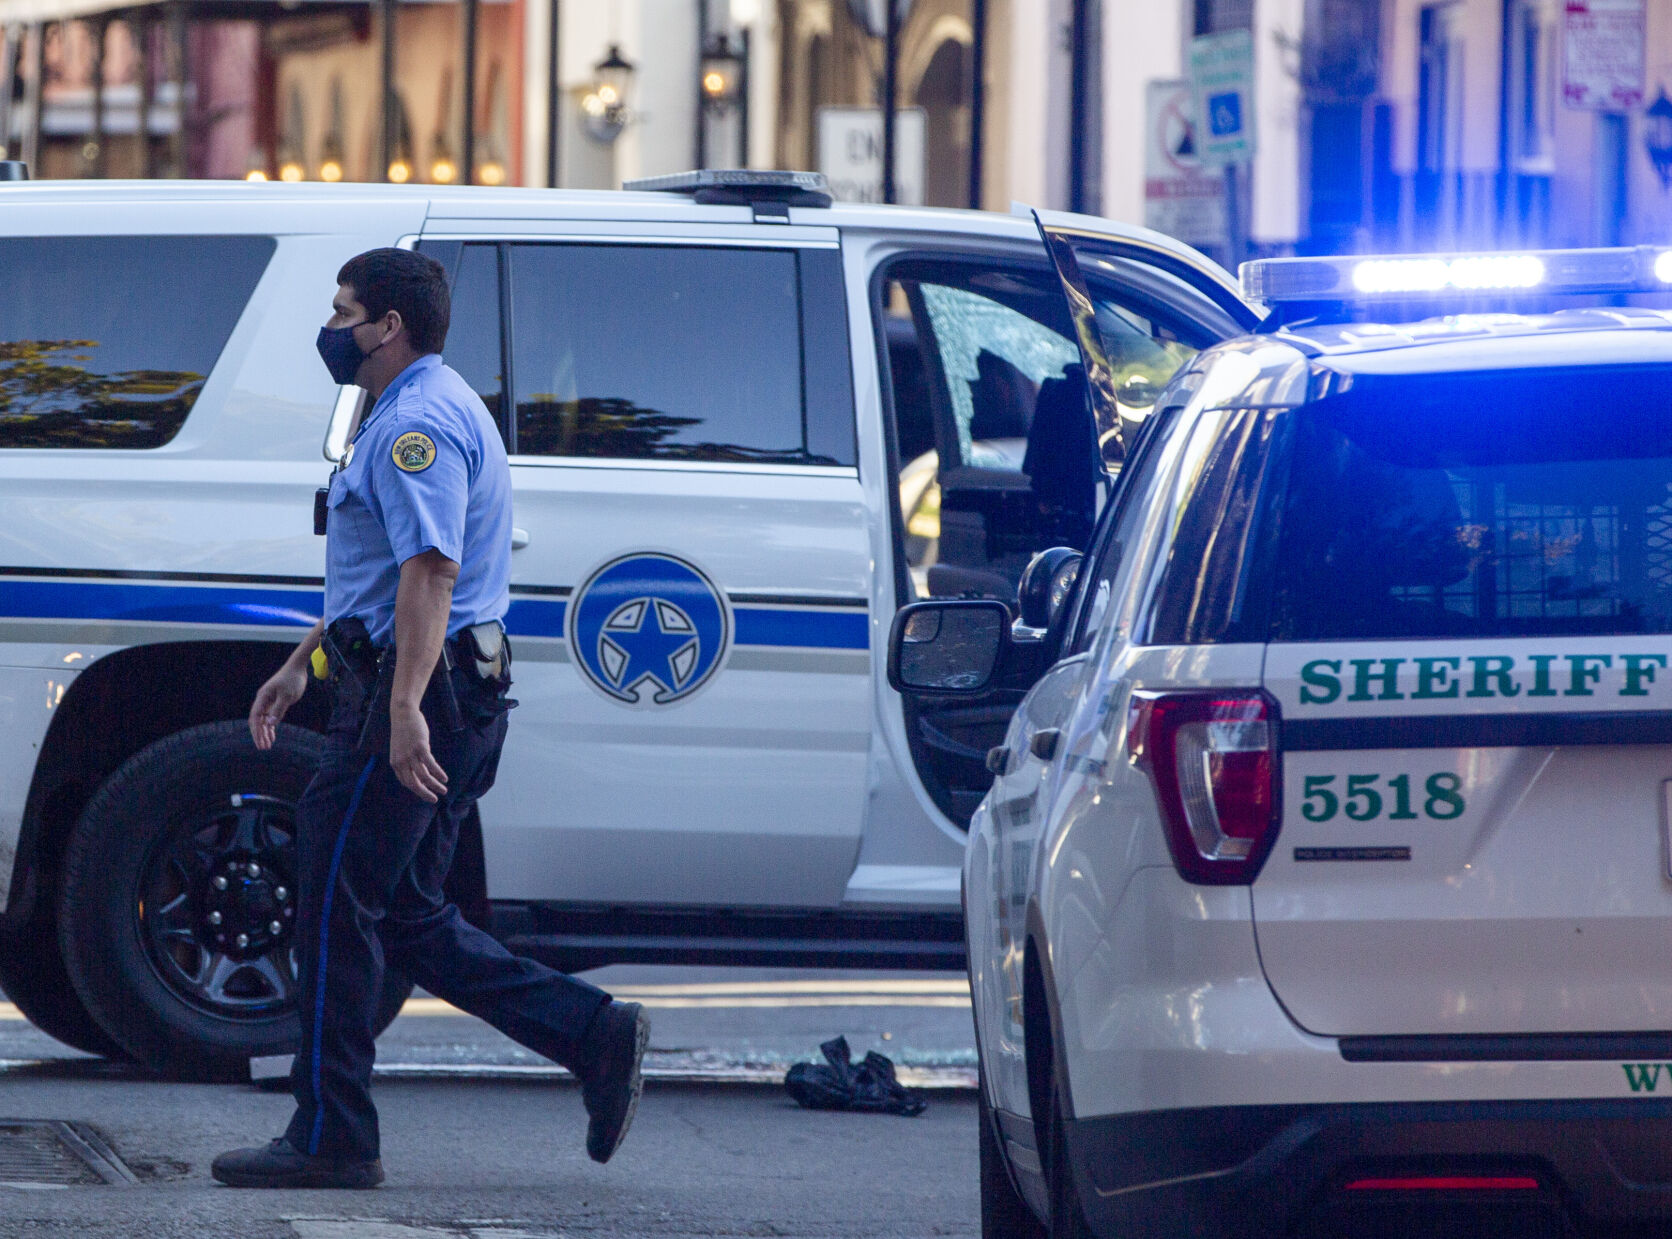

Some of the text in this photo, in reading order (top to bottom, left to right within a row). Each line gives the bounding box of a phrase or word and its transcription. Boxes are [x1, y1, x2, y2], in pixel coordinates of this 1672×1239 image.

[1299, 653, 1668, 705] SHERIFF
[1301, 771, 1466, 822] 5518
[1621, 1063, 1672, 1092] W
